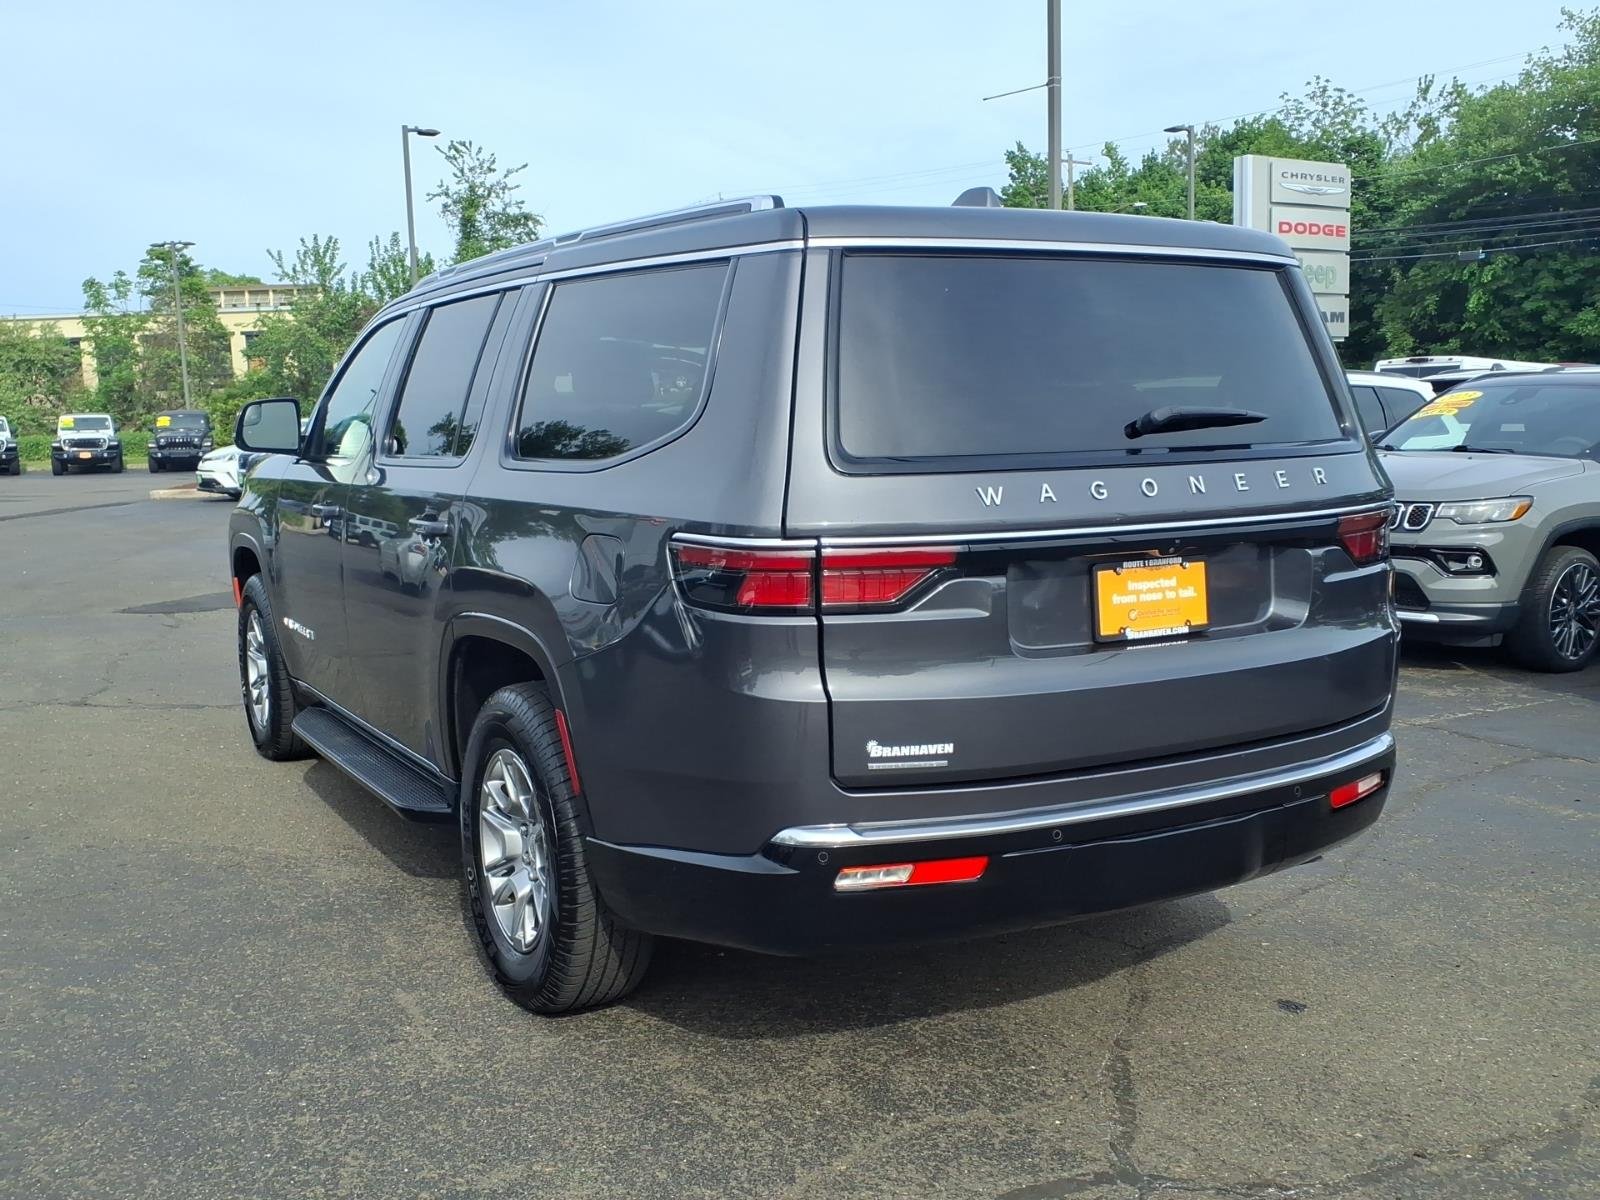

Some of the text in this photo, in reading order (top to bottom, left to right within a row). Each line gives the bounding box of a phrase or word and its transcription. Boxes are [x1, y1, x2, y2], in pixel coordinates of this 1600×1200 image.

[1281, 171, 1345, 184] CHRYSLER
[1278, 221, 1346, 237] DODGE
[1321, 311, 1345, 323] AM
[977, 467, 1328, 506] WAGONEER
[1128, 576, 1177, 591] Inspected
[1112, 594, 1137, 605] from
[1139, 592, 1163, 602] nose
[1165, 590, 1176, 599] to
[869, 743, 954, 757] BRANHAVEN
